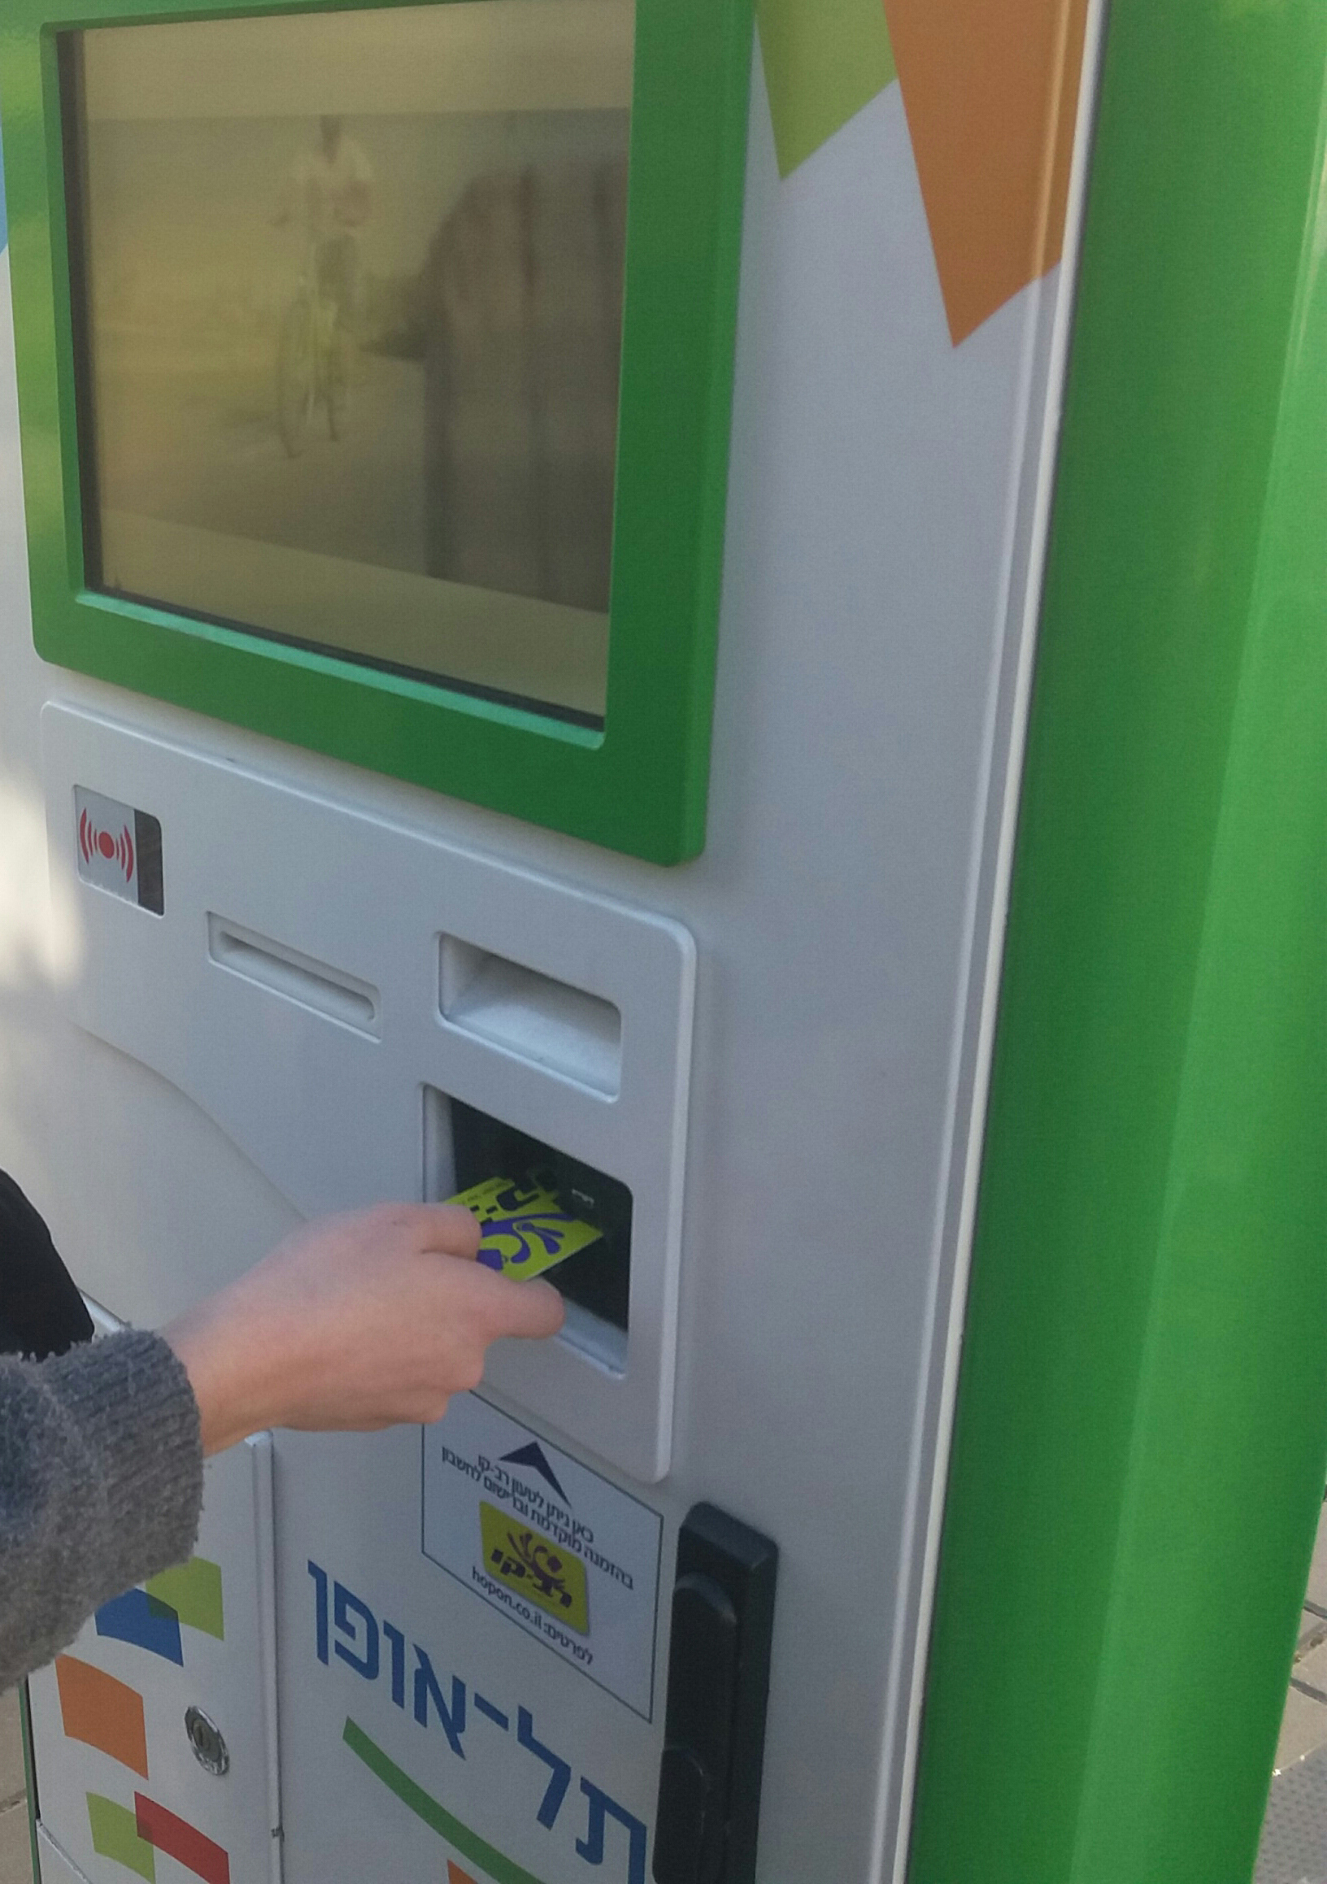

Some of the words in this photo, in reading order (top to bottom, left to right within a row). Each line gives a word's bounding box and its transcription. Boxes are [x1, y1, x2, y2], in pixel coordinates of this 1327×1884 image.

[441, 1446, 482, 1482] לחשבון
[478, 1454, 510, 1486] רב-קו
[511, 1477, 544, 1509] לטעון
[530, 1509, 582, 1554] מוקדמת
[546, 1501, 570, 1529] ניתן
[572, 1519, 594, 1543] כאן
[584, 1546, 634, 1591] בהזמנה
[472, 1565, 543, 1631] hopon.co.il
[307, 1558, 648, 1884] תל-אופן
